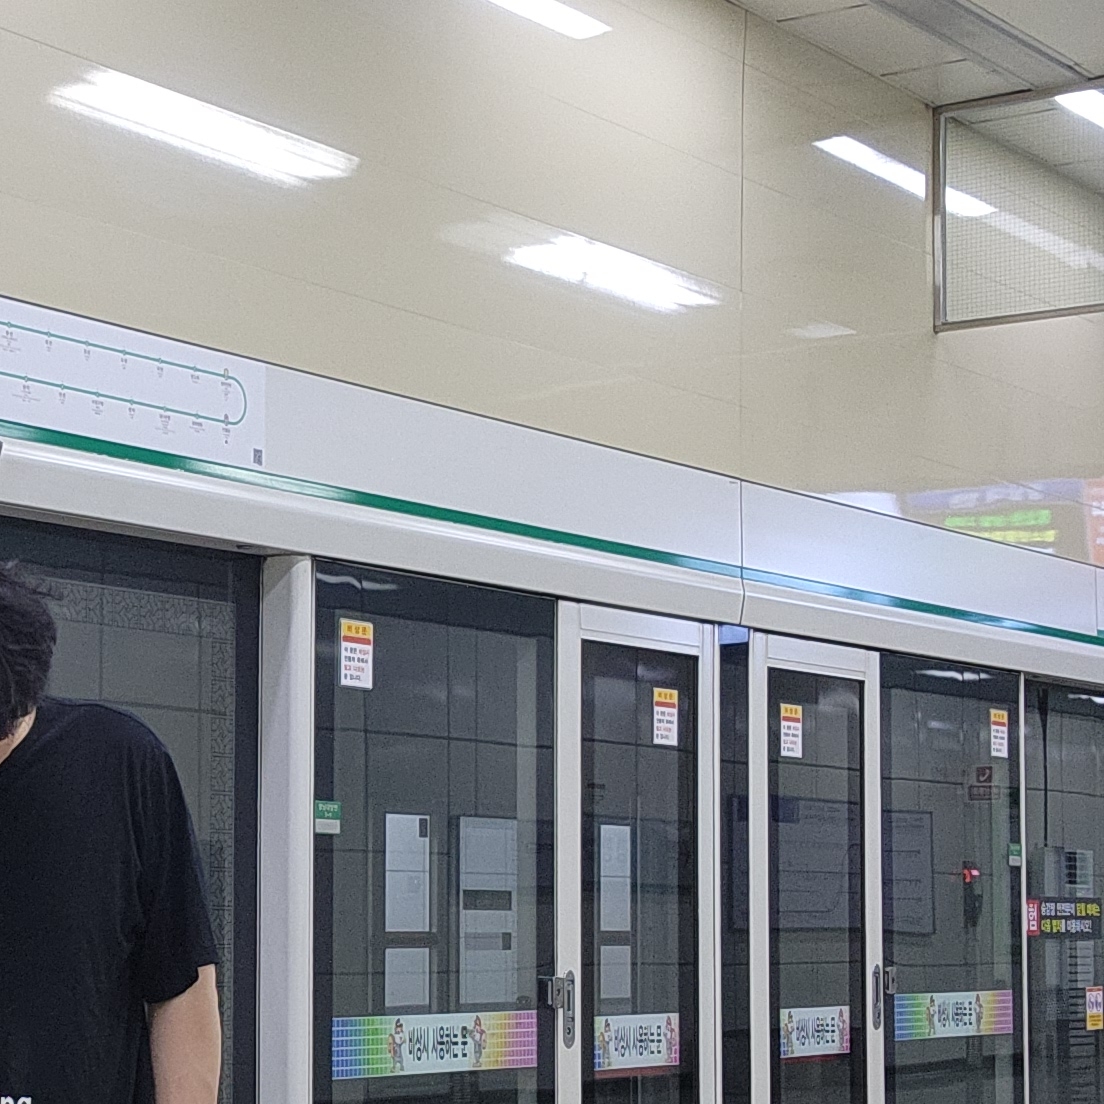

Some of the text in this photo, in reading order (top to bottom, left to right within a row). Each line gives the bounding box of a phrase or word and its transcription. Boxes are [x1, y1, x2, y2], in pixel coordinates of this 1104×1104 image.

[409, 1025, 468, 1062] 비상시 사용하는 문
